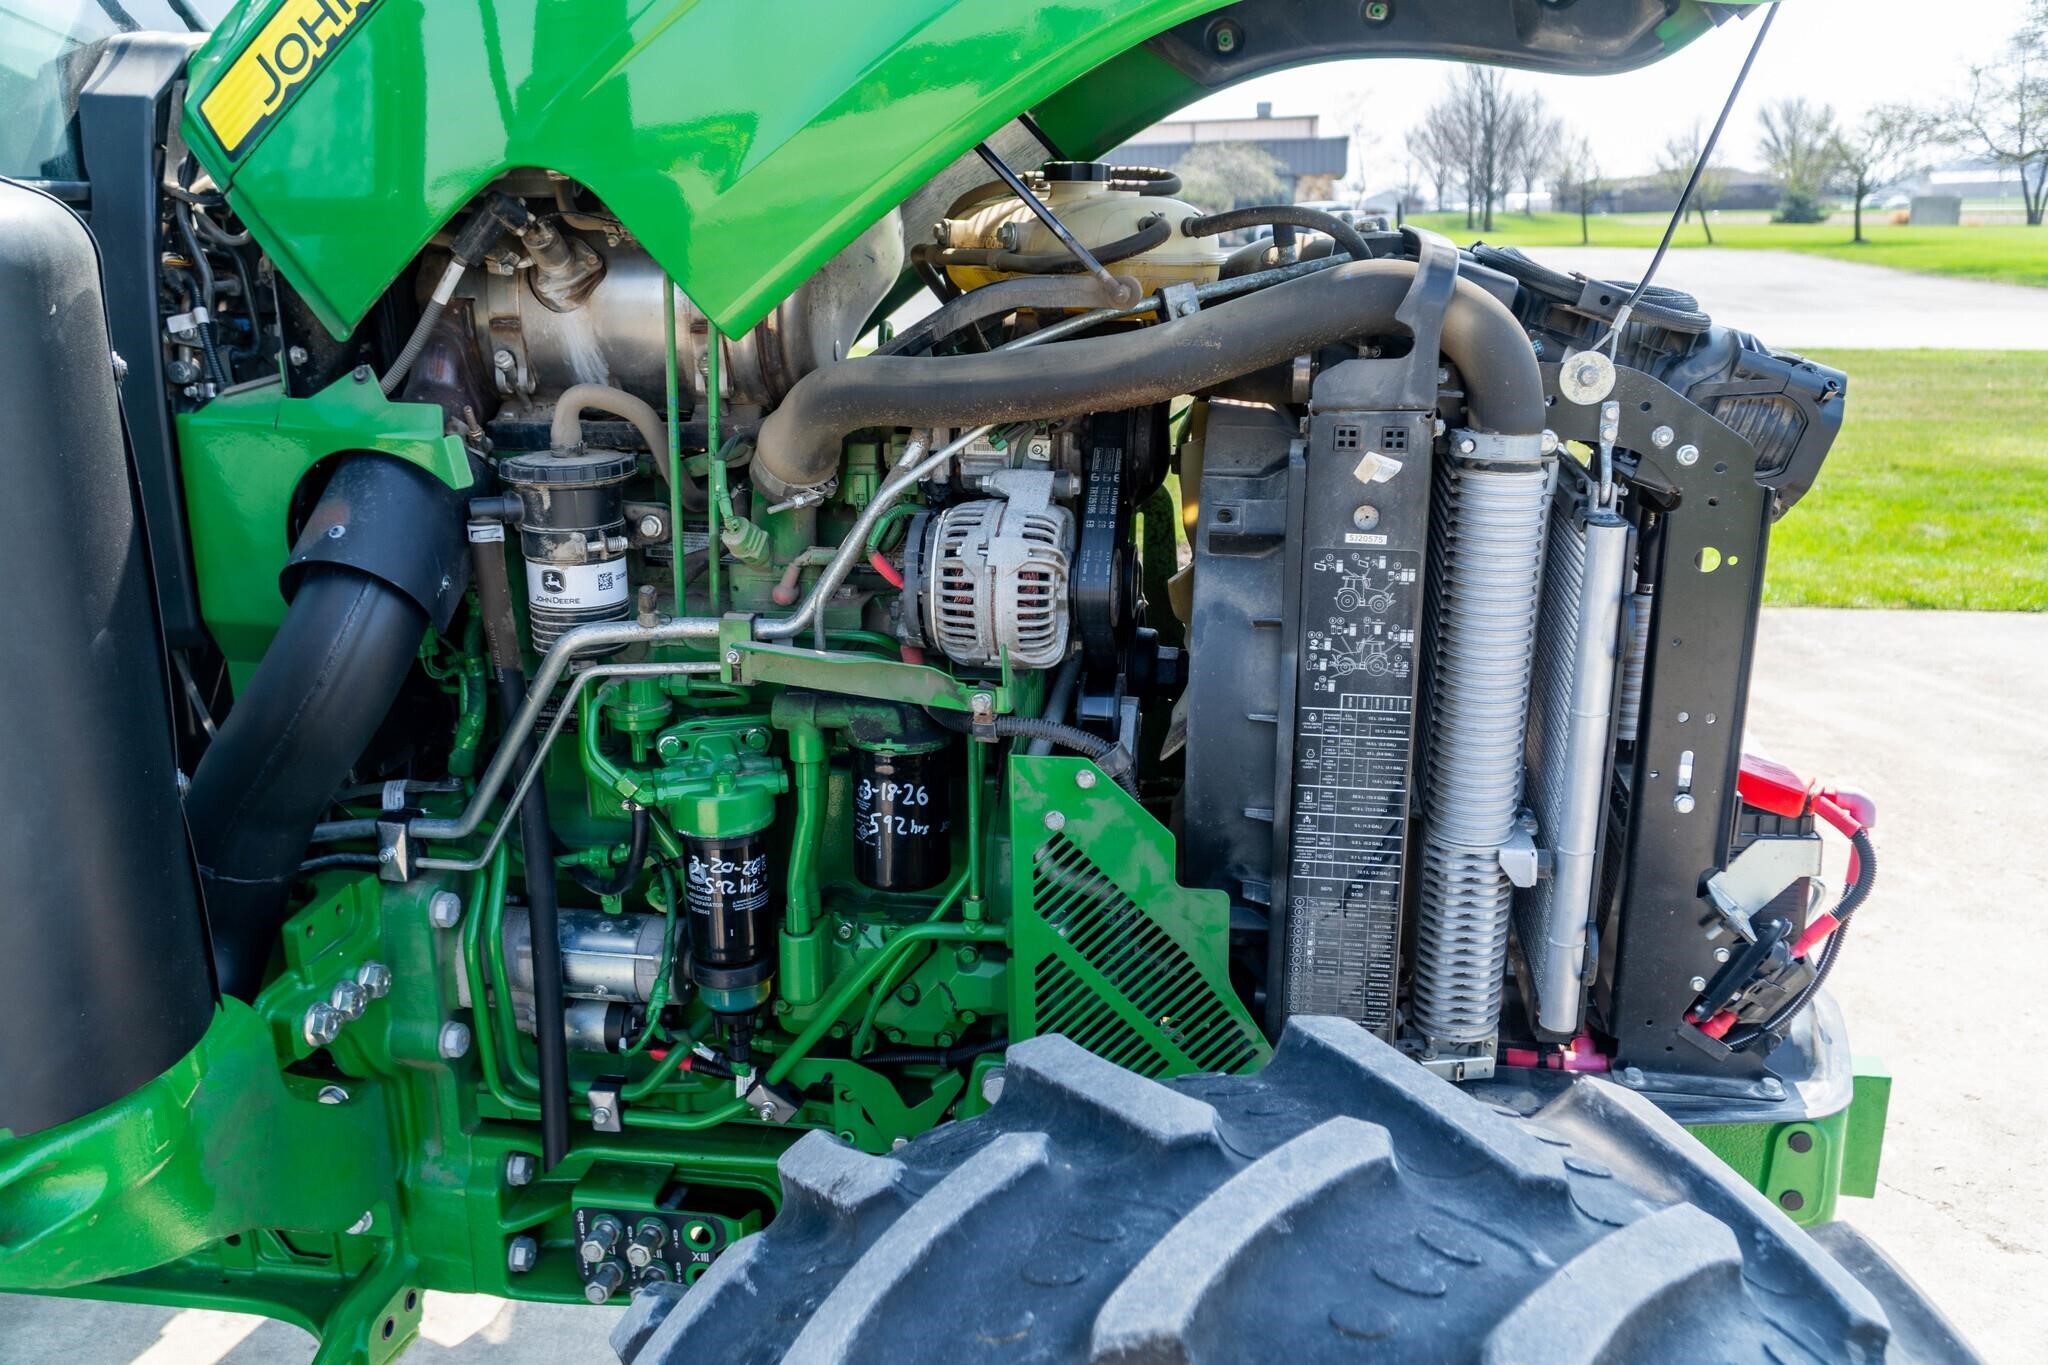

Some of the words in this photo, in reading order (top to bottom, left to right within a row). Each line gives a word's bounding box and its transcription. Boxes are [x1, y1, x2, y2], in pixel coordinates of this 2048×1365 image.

[256, 0, 353, 106] JOH
[535, 594, 552, 604] JOHN
[553, 596, 581, 604] DEERE
[863, 779, 929, 806] 3-18-26
[869, 812, 907, 835] 592
[910, 819, 930, 835] hrs
[705, 877, 737, 895] 592
[691, 1251, 710, 1262] XIII
